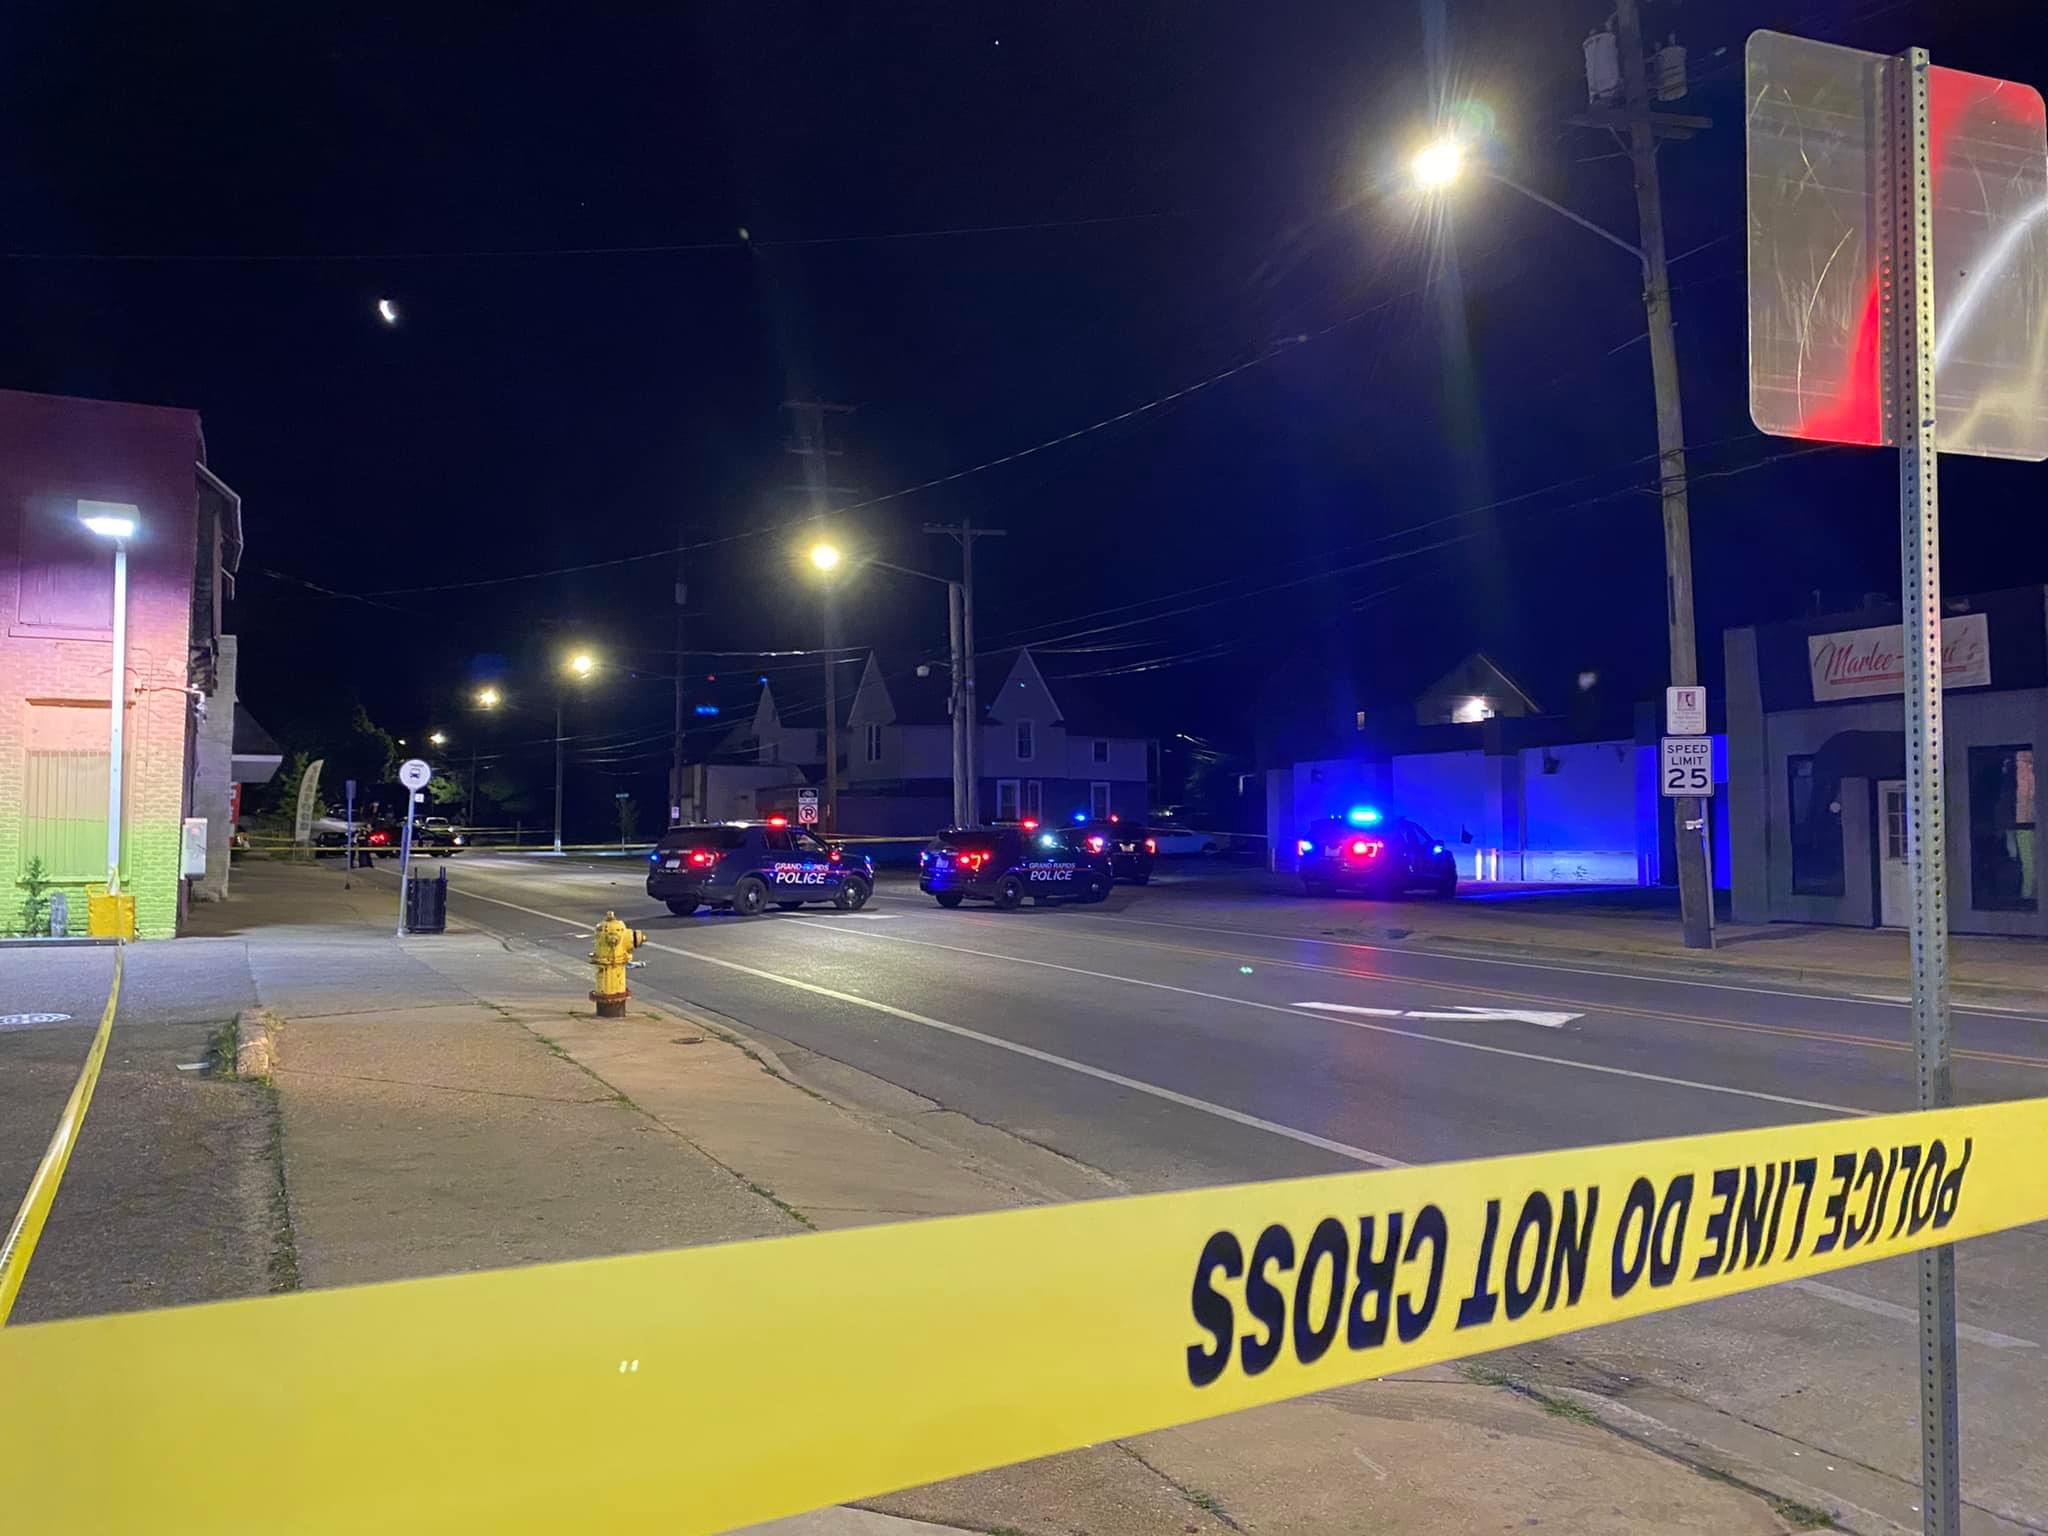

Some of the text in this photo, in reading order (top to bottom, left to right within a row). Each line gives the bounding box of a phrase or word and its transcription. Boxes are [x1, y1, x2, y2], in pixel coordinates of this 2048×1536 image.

[1667, 744, 1709, 754] SPEED
[1671, 756, 1704, 766] LIMIT
[1668, 768, 1708, 789] 25
[774, 862, 802, 871] GRAND
[776, 872, 826, 884] POLICE
[1030, 870, 1074, 881] POLICE
[1186, 1137, 1973, 1389] POLICE LINE DO NOT CROSS
